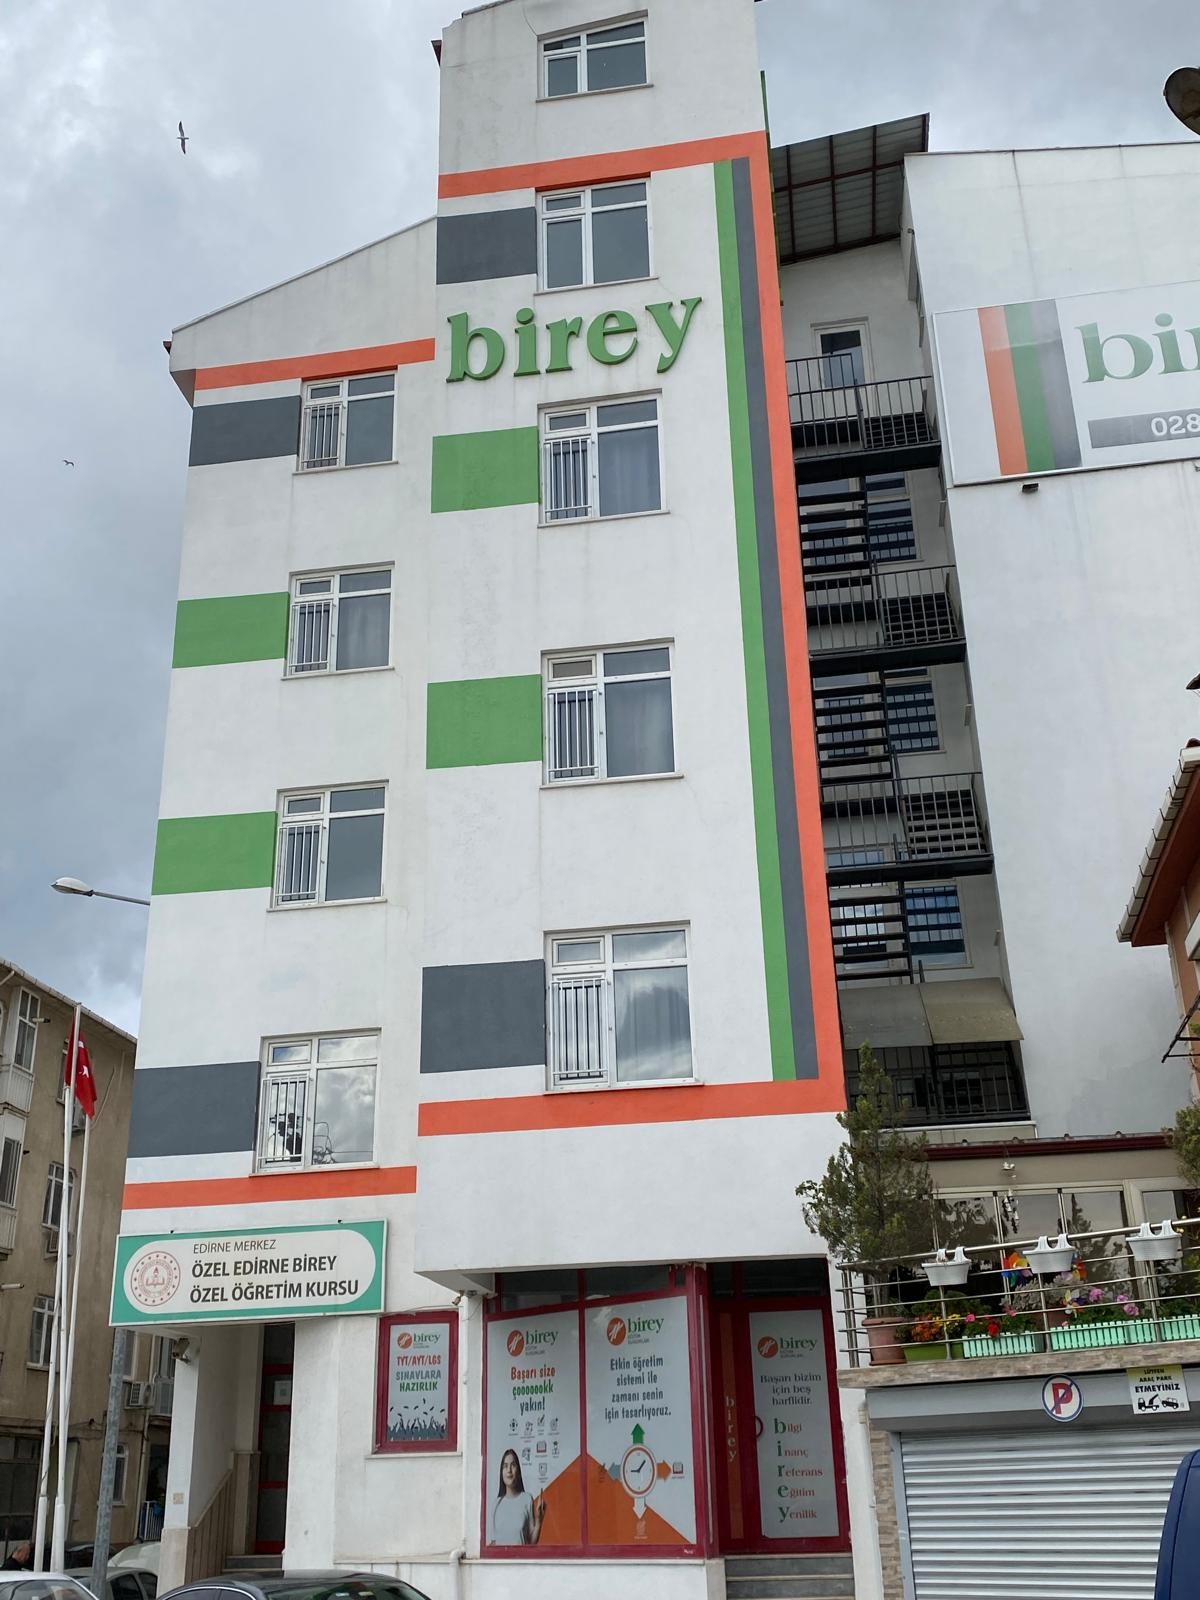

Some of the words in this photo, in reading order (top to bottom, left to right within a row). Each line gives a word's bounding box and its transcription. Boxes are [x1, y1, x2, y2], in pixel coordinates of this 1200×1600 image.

[446, 297, 702, 383] birey
[193, 1241, 231, 1254] EDİRNE
[233, 1239, 276, 1251] MERKEZ
[191, 1260, 230, 1278] ÖZEL
[233, 1256, 289, 1276] EDİRNE
[292, 1253, 337, 1273] BİREY
[190, 1285, 228, 1303] ÖZEL
[231, 1279, 302, 1301] ÖĞRETİM
[305, 1279, 359, 1297] KURSU
[627, 1318, 664, 1334] birey
[413, 1332, 440, 1343] birey
[525, 1329, 558, 1346] birey
[780, 1337, 817, 1351] birey
[610, 1357, 630, 1371] Etkin
[633, 1355, 663, 1372] öğretim
[511, 1366, 536, 1383] Başarı
[540, 1364, 555, 1378] size
[616, 1371, 644, 1386] sistemi
[399, 1381, 438, 1392] HAZIRLIK
[642, 1388, 663, 1401] senin
[1135, 1383, 1181, 1393] ETMEYİNİZ
[520, 1396, 546, 1416] yakın!
